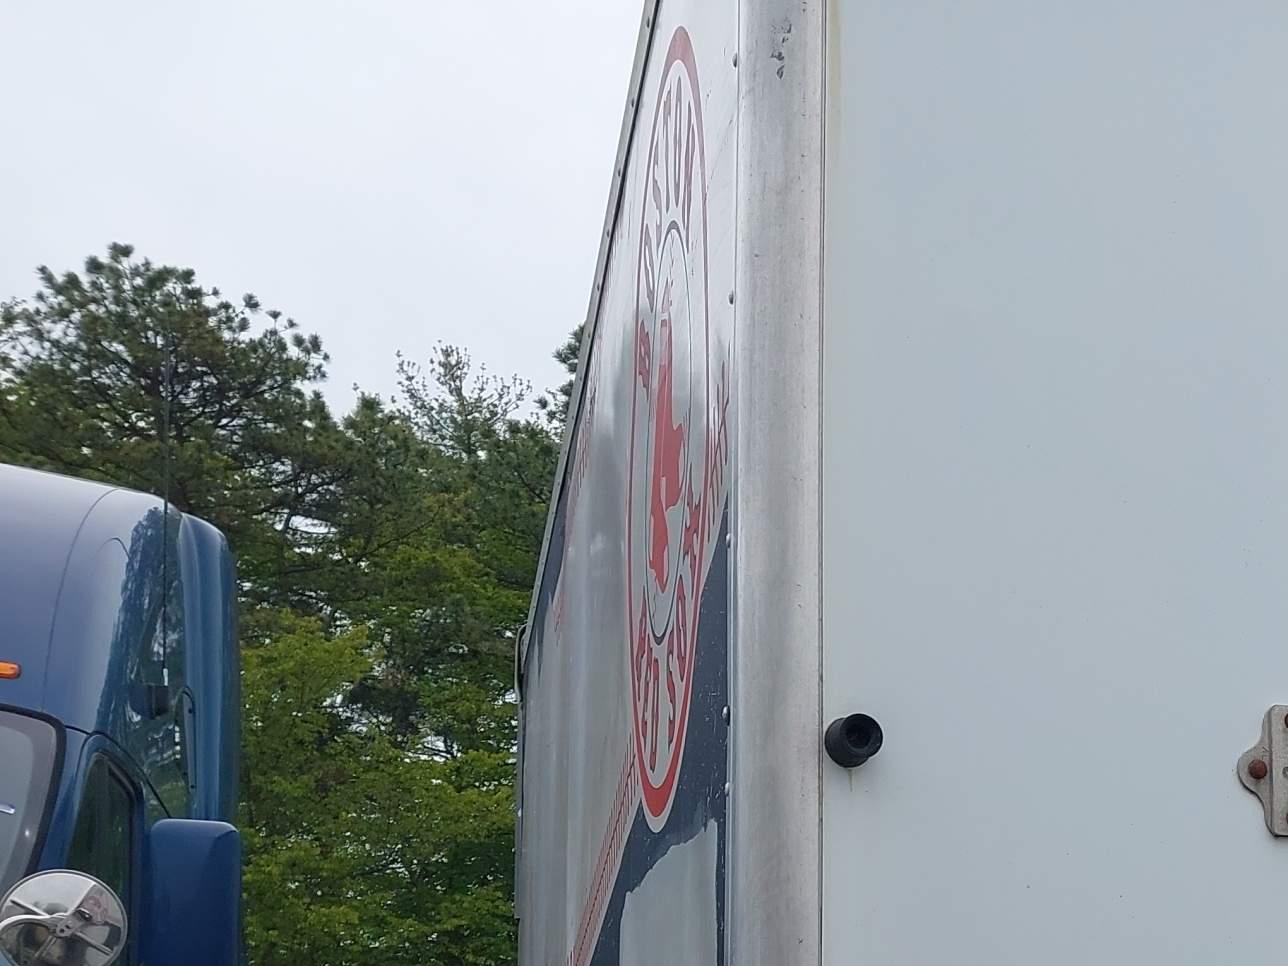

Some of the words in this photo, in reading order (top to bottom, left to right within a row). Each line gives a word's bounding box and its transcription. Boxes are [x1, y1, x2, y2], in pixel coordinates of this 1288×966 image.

[638, 74, 696, 402] BOSTON
[635, 584, 660, 774] RED
[665, 461, 702, 752] SOX
